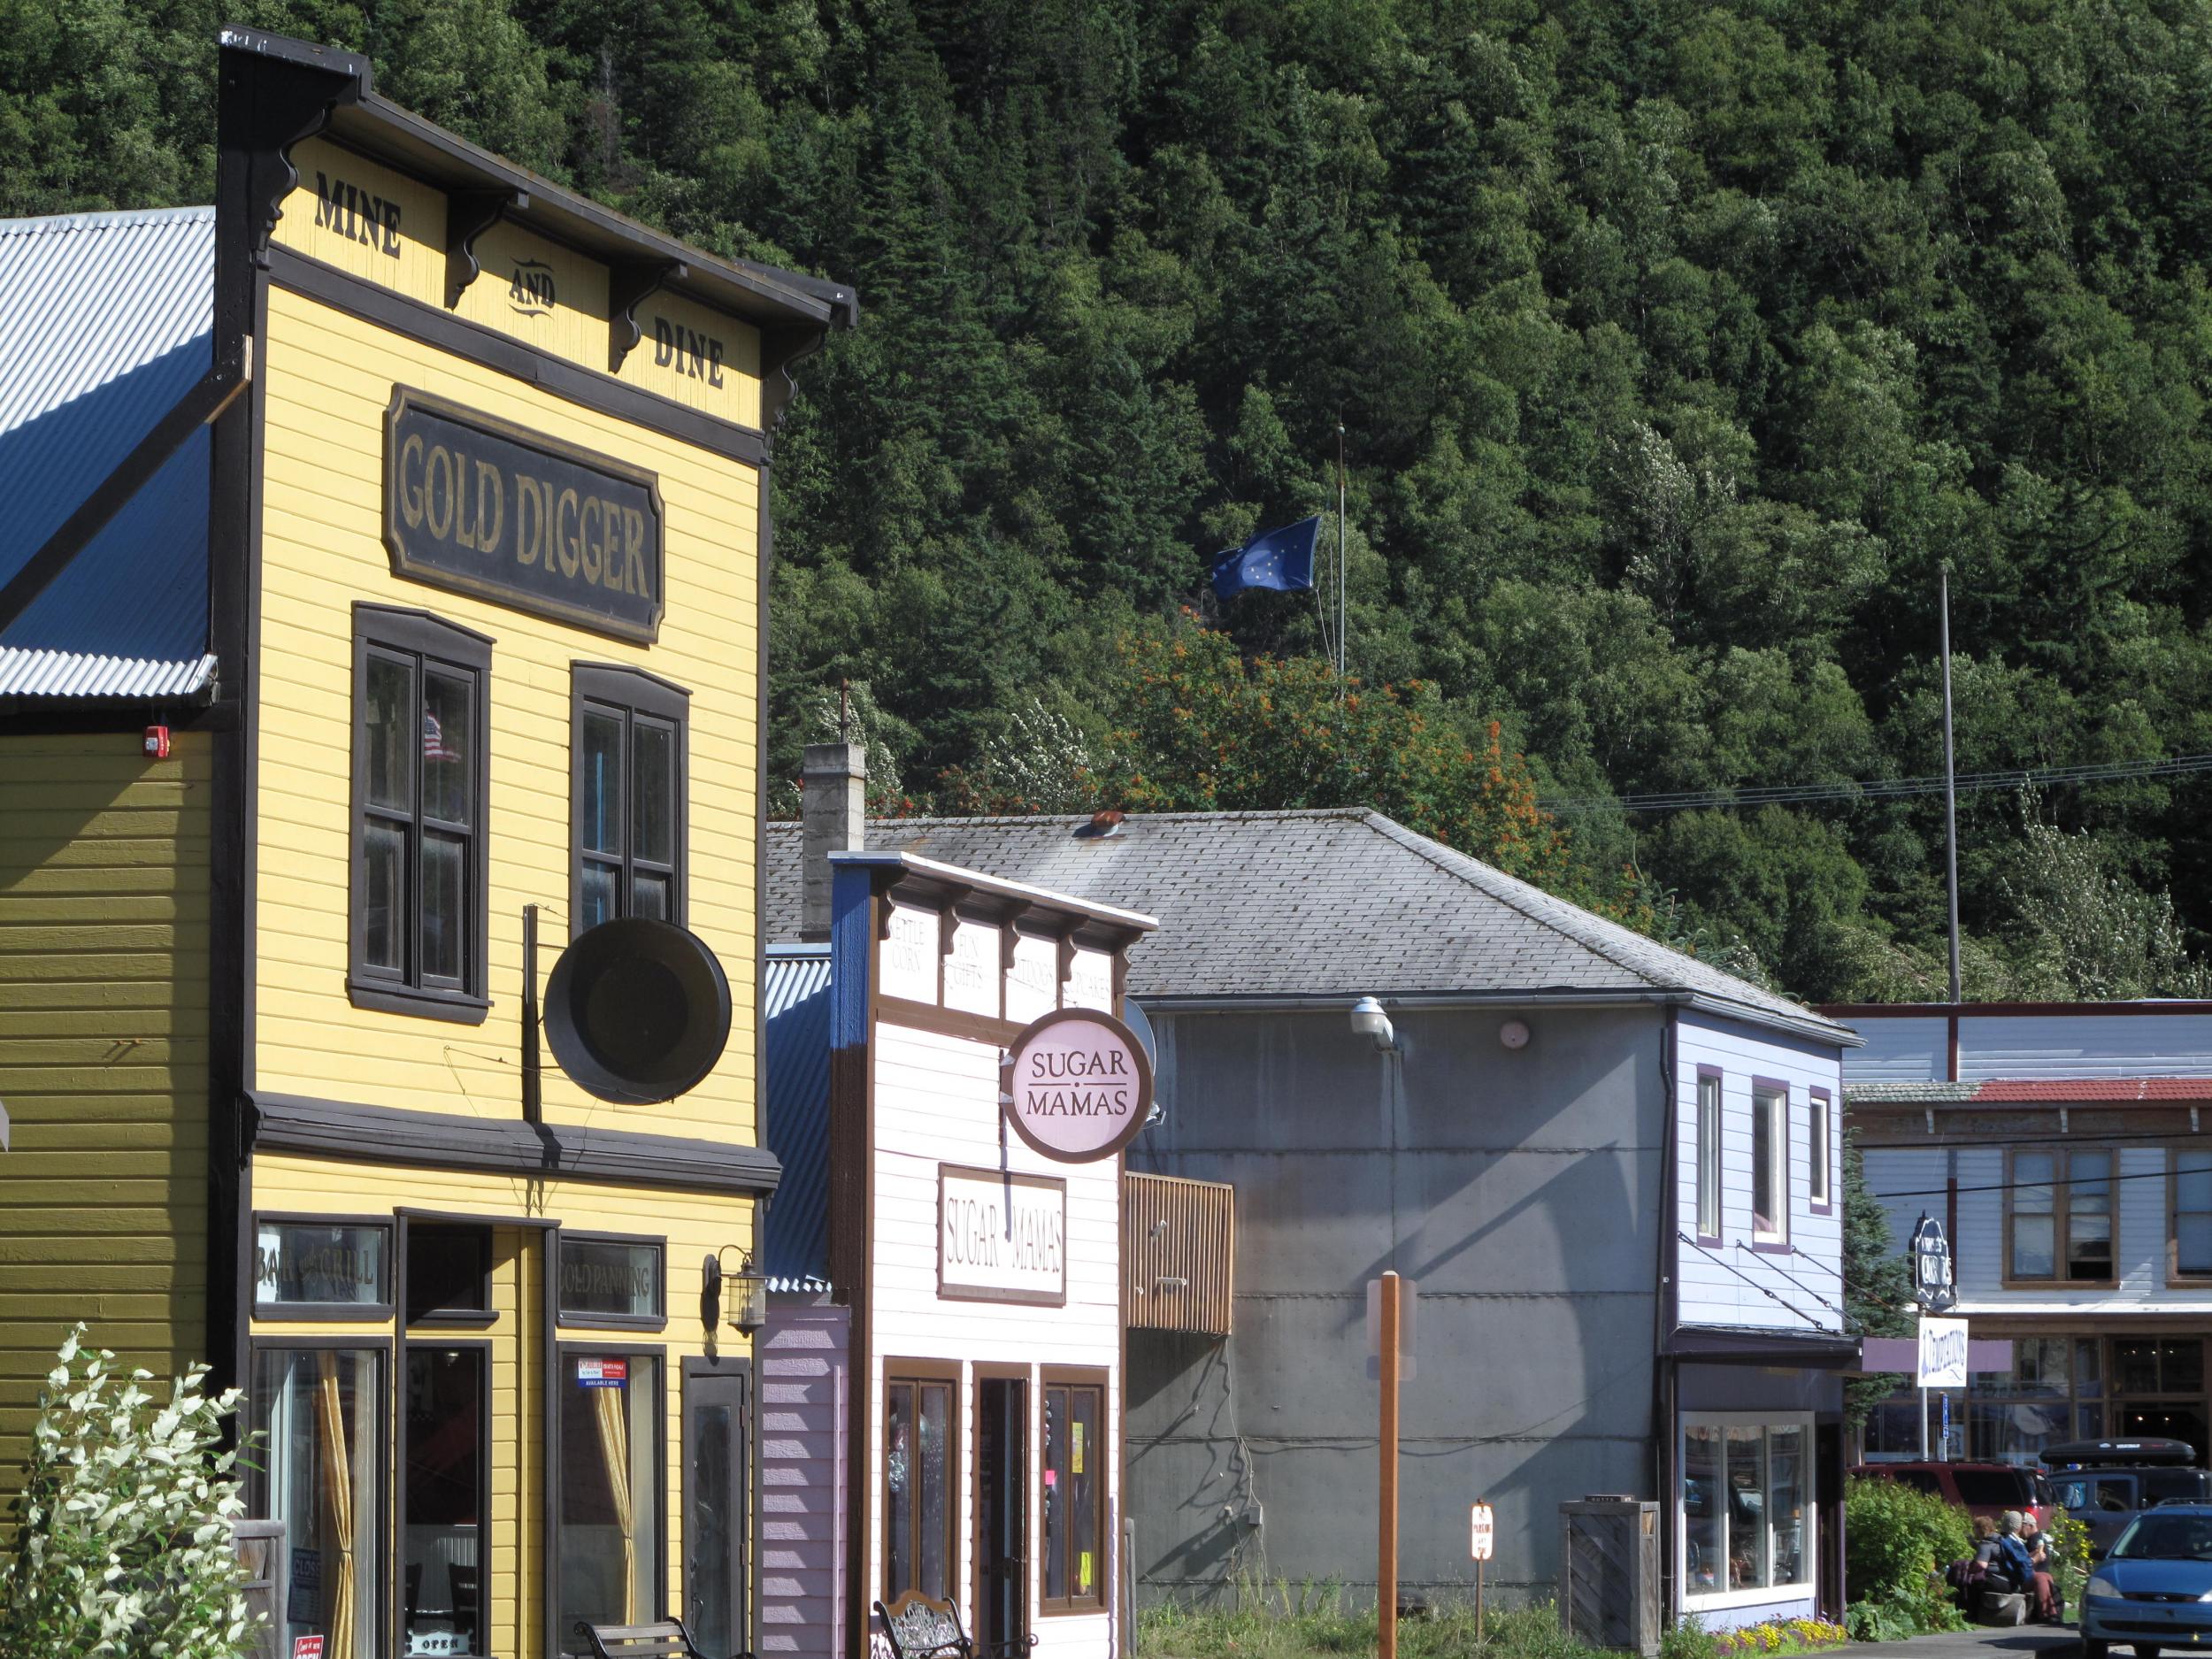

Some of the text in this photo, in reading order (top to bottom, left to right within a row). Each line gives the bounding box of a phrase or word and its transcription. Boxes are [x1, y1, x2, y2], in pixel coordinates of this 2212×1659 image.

[315, 171, 402, 260] MINE
[508, 267, 557, 310] AND
[654, 317, 724, 390] DINE
[398, 433, 650, 599] GOLD DIGGER
[1032, 1050, 1128, 1078] SUGAR
[1025, 1090, 1127, 1116] MAMAS
[947, 1197, 1061, 1273] SUGAR MAMAS
[256, 1247, 294, 1282] BAR
[320, 1248, 374, 1285] GRILL
[594, 1265, 650, 1298] PANNING
[422, 1638, 458, 1649] OPEN
